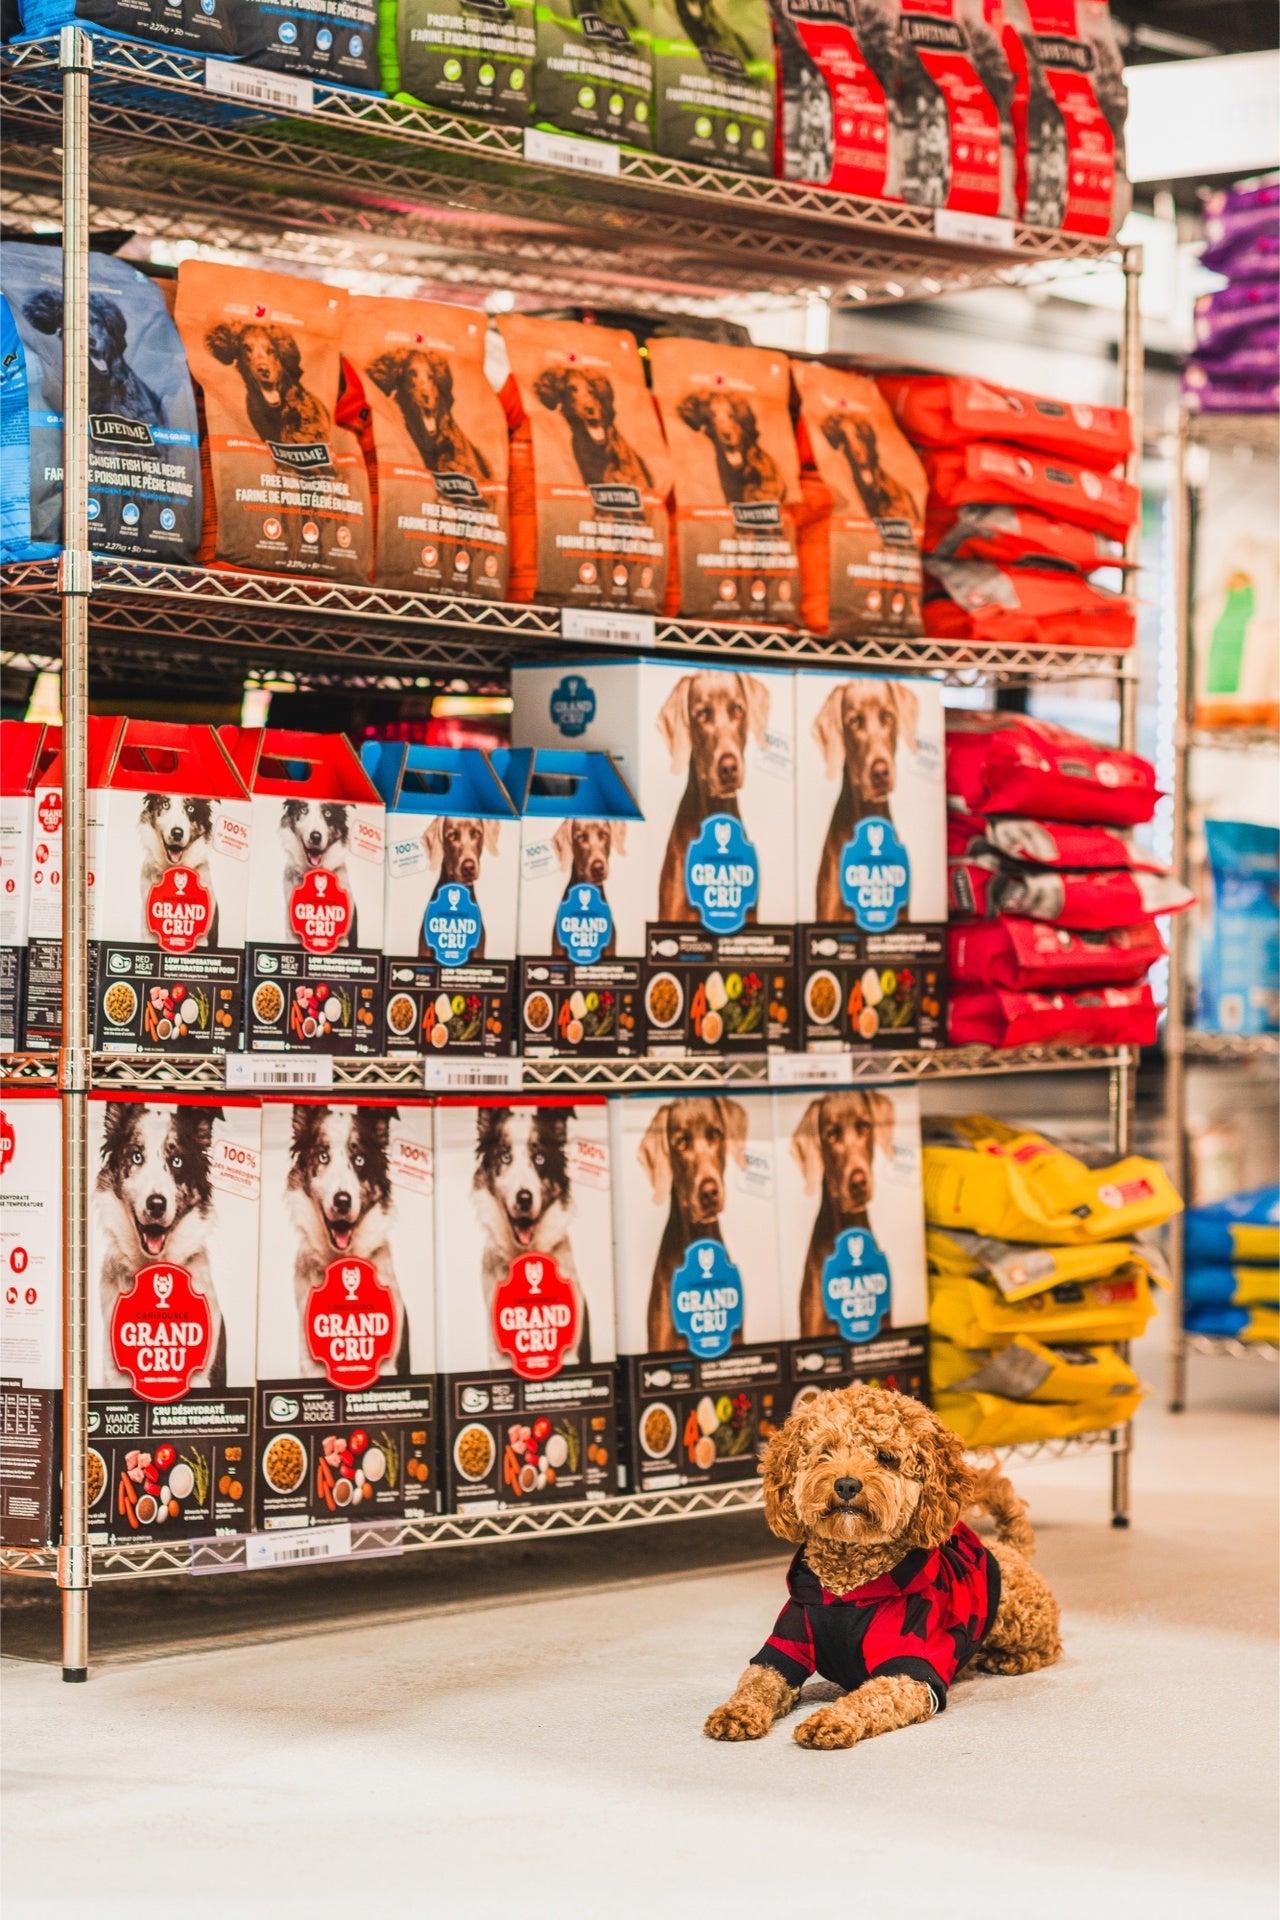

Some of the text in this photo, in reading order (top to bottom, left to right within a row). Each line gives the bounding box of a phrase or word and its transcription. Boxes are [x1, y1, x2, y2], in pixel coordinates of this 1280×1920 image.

[96, 420, 149, 440] LIFETIME
[88, 453, 121, 469] CAUGHT
[122, 457, 142, 472] FISH
[142, 460, 162, 475] MEAL
[44, 467, 64, 481] FAR
[94, 470, 131, 487] POISSON
[131, 474, 142, 488] DE
[260, 474, 282, 488] FREE
[235, 488, 268, 504] FARINE
[105, 541, 127, 553] 2.27kg
[223, 819, 248, 838] 100%
[358, 823, 383, 841] 100%
[394, 841, 420, 855] 100%
[690, 864, 755, 887] GRAND
[845, 864, 907, 887] GRAND
[703, 886, 743, 909] CRU
[858, 885, 896, 909] CRU
[152, 901, 206, 921] GRAND
[295, 903, 346, 922] GRAND
[162, 918, 195, 936] CRU
[305, 919, 336, 937] CRU
[429, 917, 477, 935] GRAND
[560, 917, 608, 934] GRAND
[438, 932, 467, 949] CRU
[570, 931, 598, 948] CRU
[135, 954, 149, 964] RED
[135, 963, 154, 971] MEAT
[164, 956, 179, 965] LOW
[223, 1146, 257, 1169] 100%
[400, 1143, 429, 1164] 100%
[827, 1272, 888, 1300] GRAND
[677, 1287, 739, 1313] GRAND
[840, 1296, 877, 1319] CRU
[136, 1311, 189, 1320] CANISOURCE
[500, 1304, 571, 1330] GRAND
[690, 1310, 728, 1334] CRU
[120, 1322, 204, 1347] GRAND
[313, 1313, 390, 1338] GRAND
[329, 1337, 375, 1362] CRU
[514, 1329, 558, 1353] CRU
[137, 1347, 187, 1372] CRU
[152, 1405, 171, 1415] CRU
[302, 1400, 335, 1411] VIANDE
[105, 1413, 140, 1424] VIANDE
[160, 1415, 188, 1427] BASSE
[188, 1412, 247, 1426] TEMPÉRATURE
[303, 1410, 335, 1422] ROUGE
[105, 1424, 140, 1435] ROUGE
